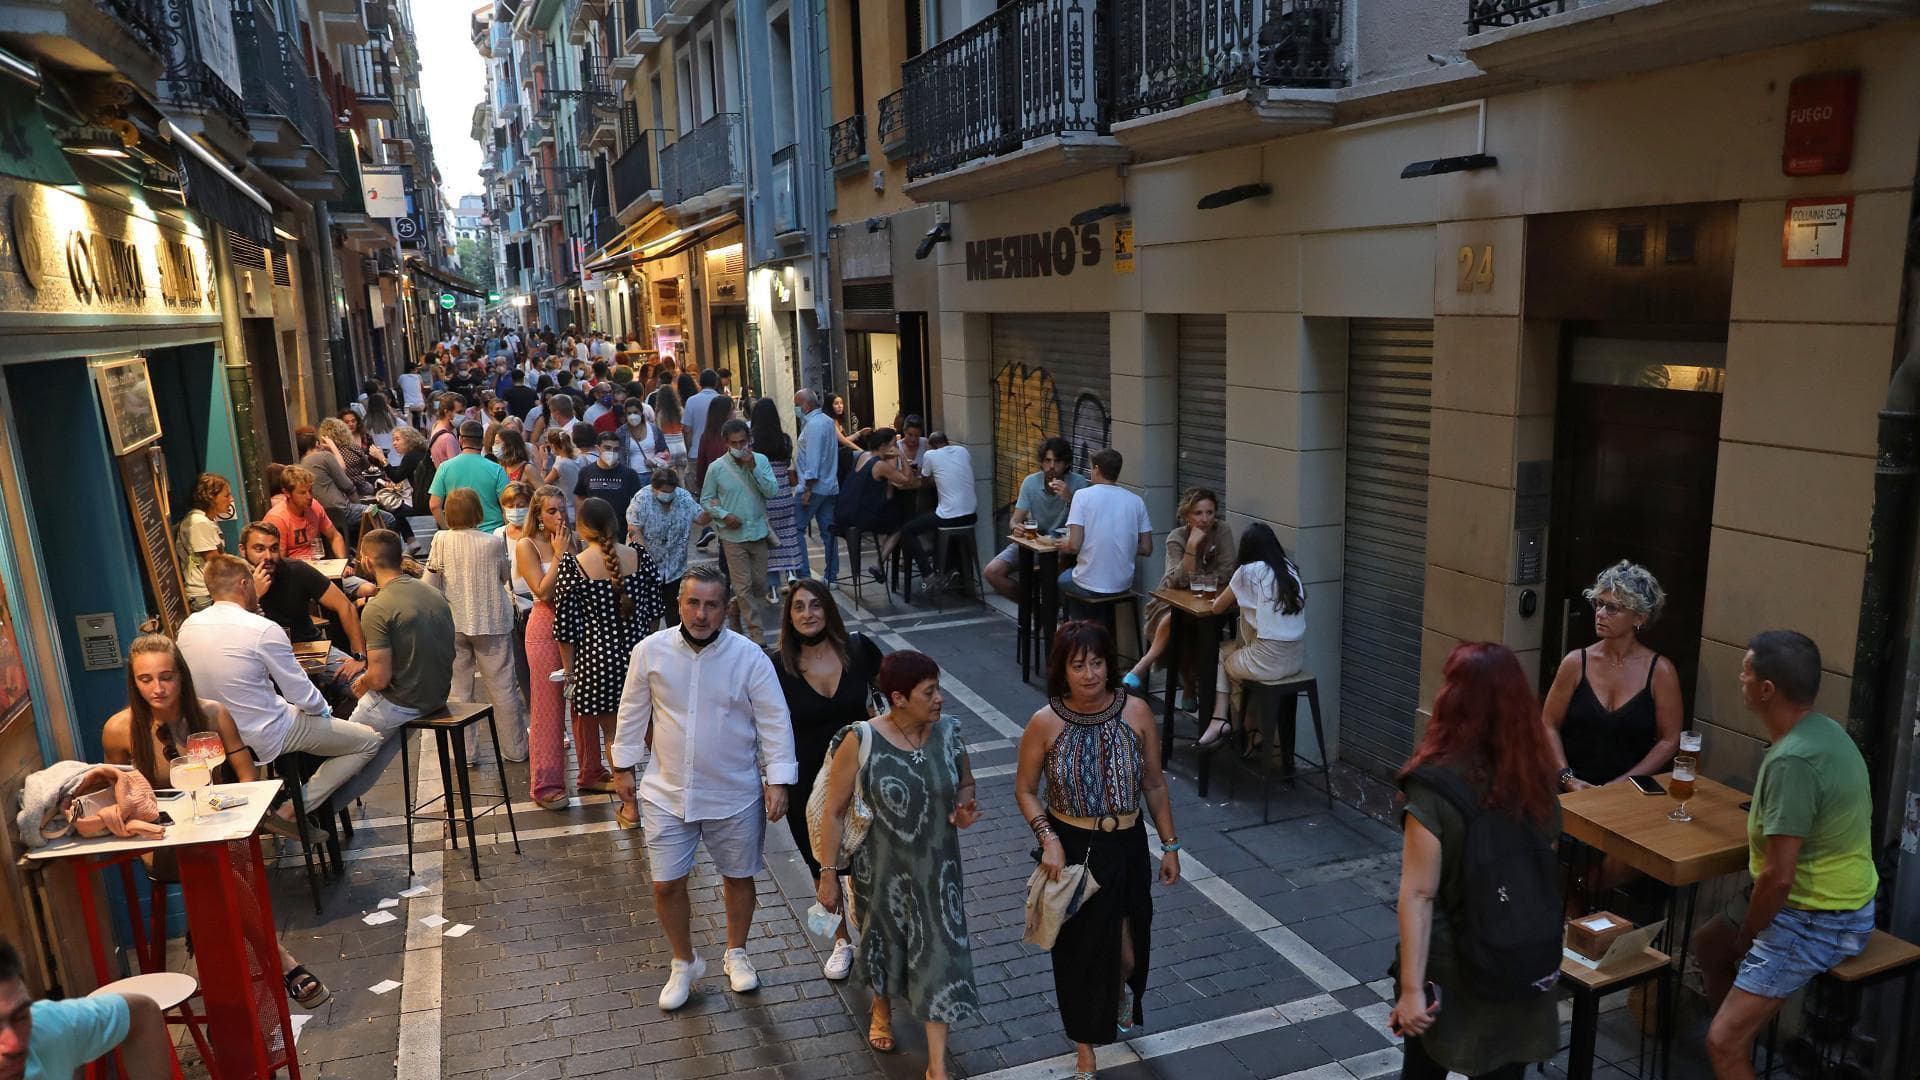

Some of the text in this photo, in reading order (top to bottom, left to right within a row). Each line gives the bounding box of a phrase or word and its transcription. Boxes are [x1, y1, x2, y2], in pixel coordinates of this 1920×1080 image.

[1790, 105, 1832, 125] FUEGO
[1793, 207, 1844, 221] COLUMNA SECA
[400, 223, 412, 233] 25
[966, 223, 1101, 281] MERINO'S
[1458, 245, 1493, 292] 24
